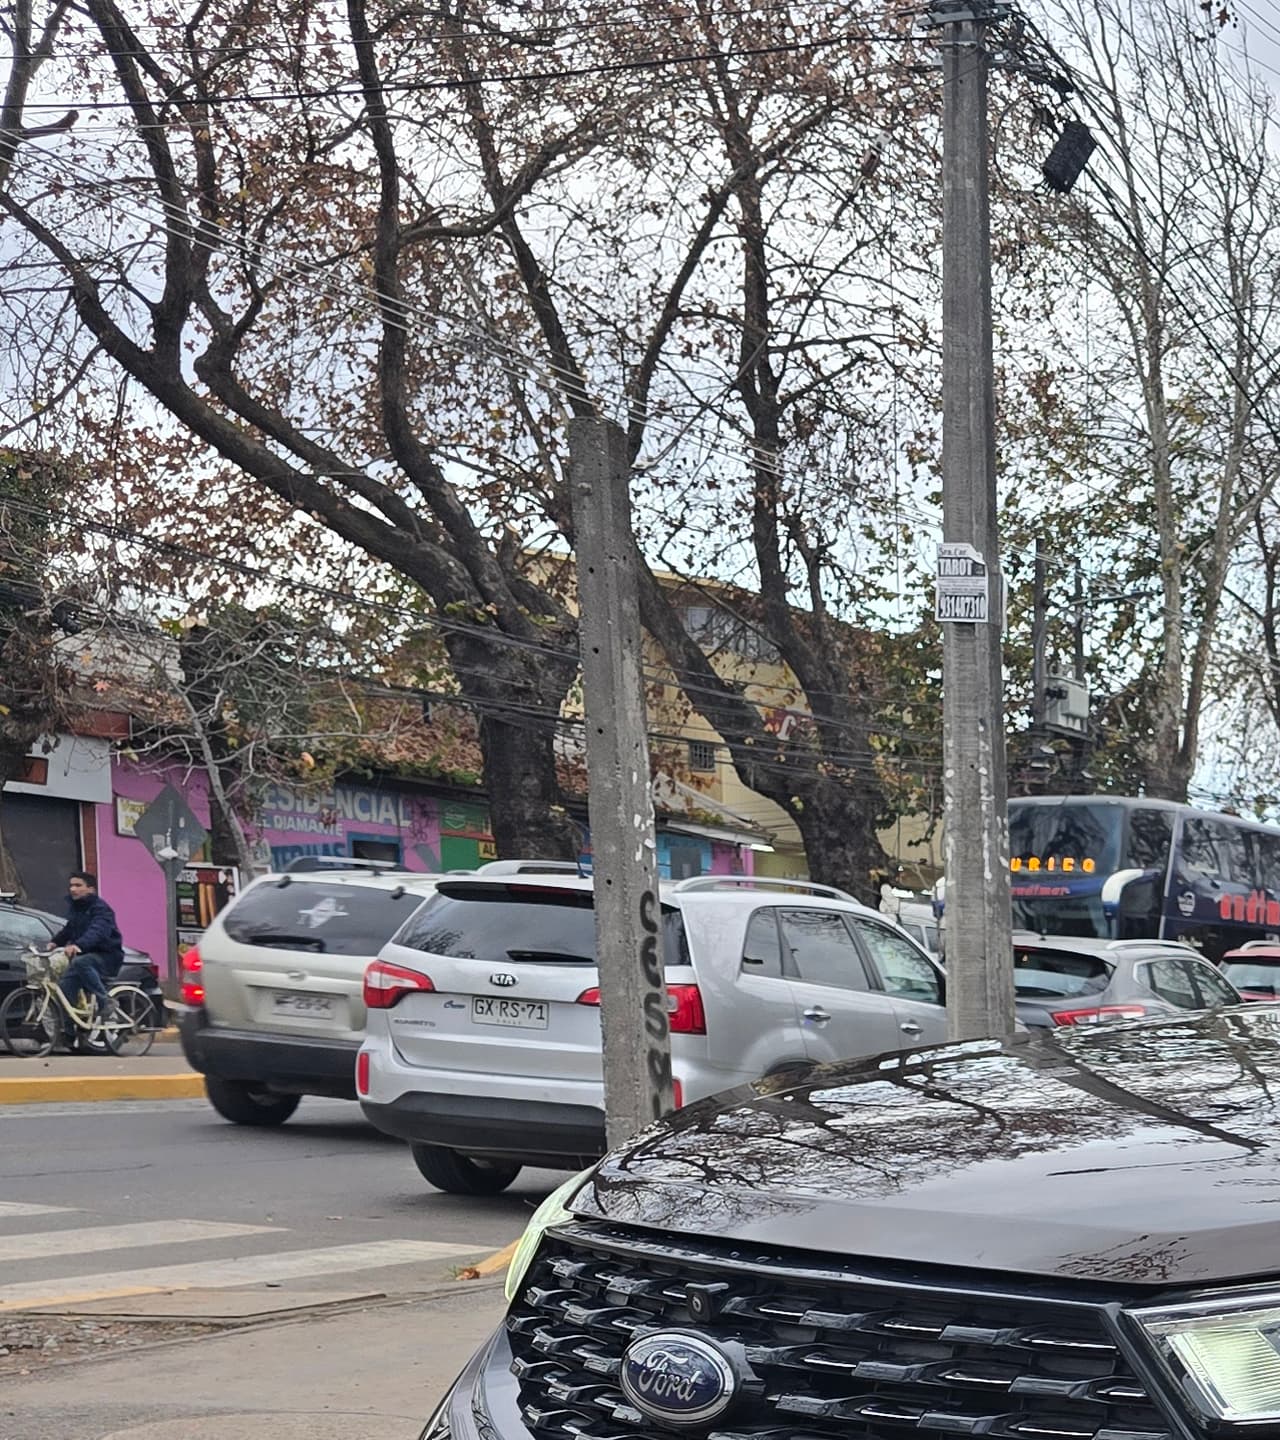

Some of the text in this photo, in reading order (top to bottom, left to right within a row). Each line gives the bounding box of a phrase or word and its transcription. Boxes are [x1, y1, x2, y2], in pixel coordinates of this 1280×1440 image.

[939, 558, 973, 576] TAROT
[490, 974, 516, 986] KIA
[639, 1350, 701, 1401] Ford
